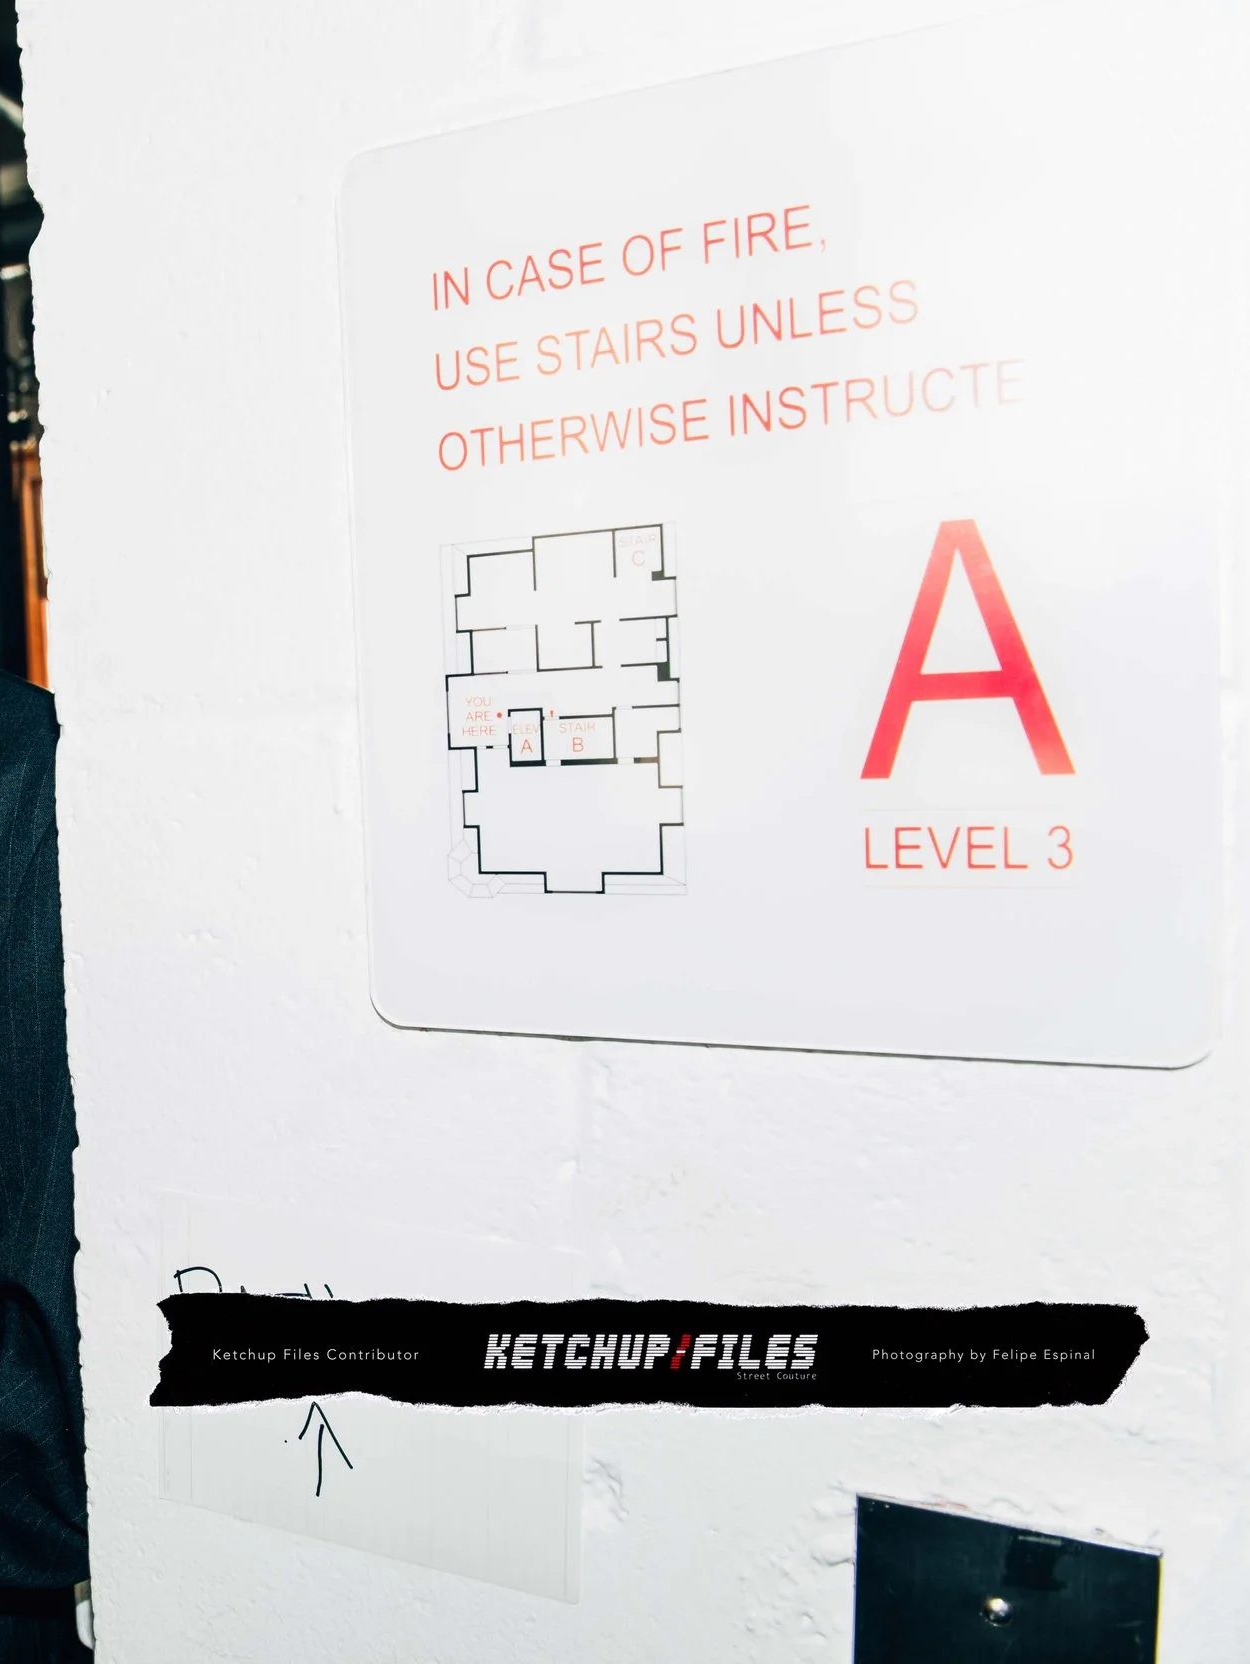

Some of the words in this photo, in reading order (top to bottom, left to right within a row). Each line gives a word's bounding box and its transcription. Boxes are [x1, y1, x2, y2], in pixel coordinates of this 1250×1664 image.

[432, 266, 470, 311] IN
[486, 242, 605, 300] CASE
[622, 227, 683, 277] OF
[703, 204, 827, 264] FIRE,
[435, 340, 520, 391] USE
[536, 313, 698, 376] STAIRS
[716, 279, 919, 349] UNLESS
[438, 397, 710, 471] OTHERWISE
[729, 357, 1027, 437] INSTRUCTE
[631, 549, 646, 567] C
[860, 519, 1076, 780] A
[465, 695, 492, 707] YOU
[465, 711, 492, 722] ARE
[462, 725, 497, 736] HERE
[513, 724, 540, 735] ELEV
[559, 721, 597, 733] STAIR
[520, 738, 534, 754] A
[572, 737, 584, 752] B
[864, 826, 1029, 870] LEVEL
[1047, 825, 1074, 870] 3
